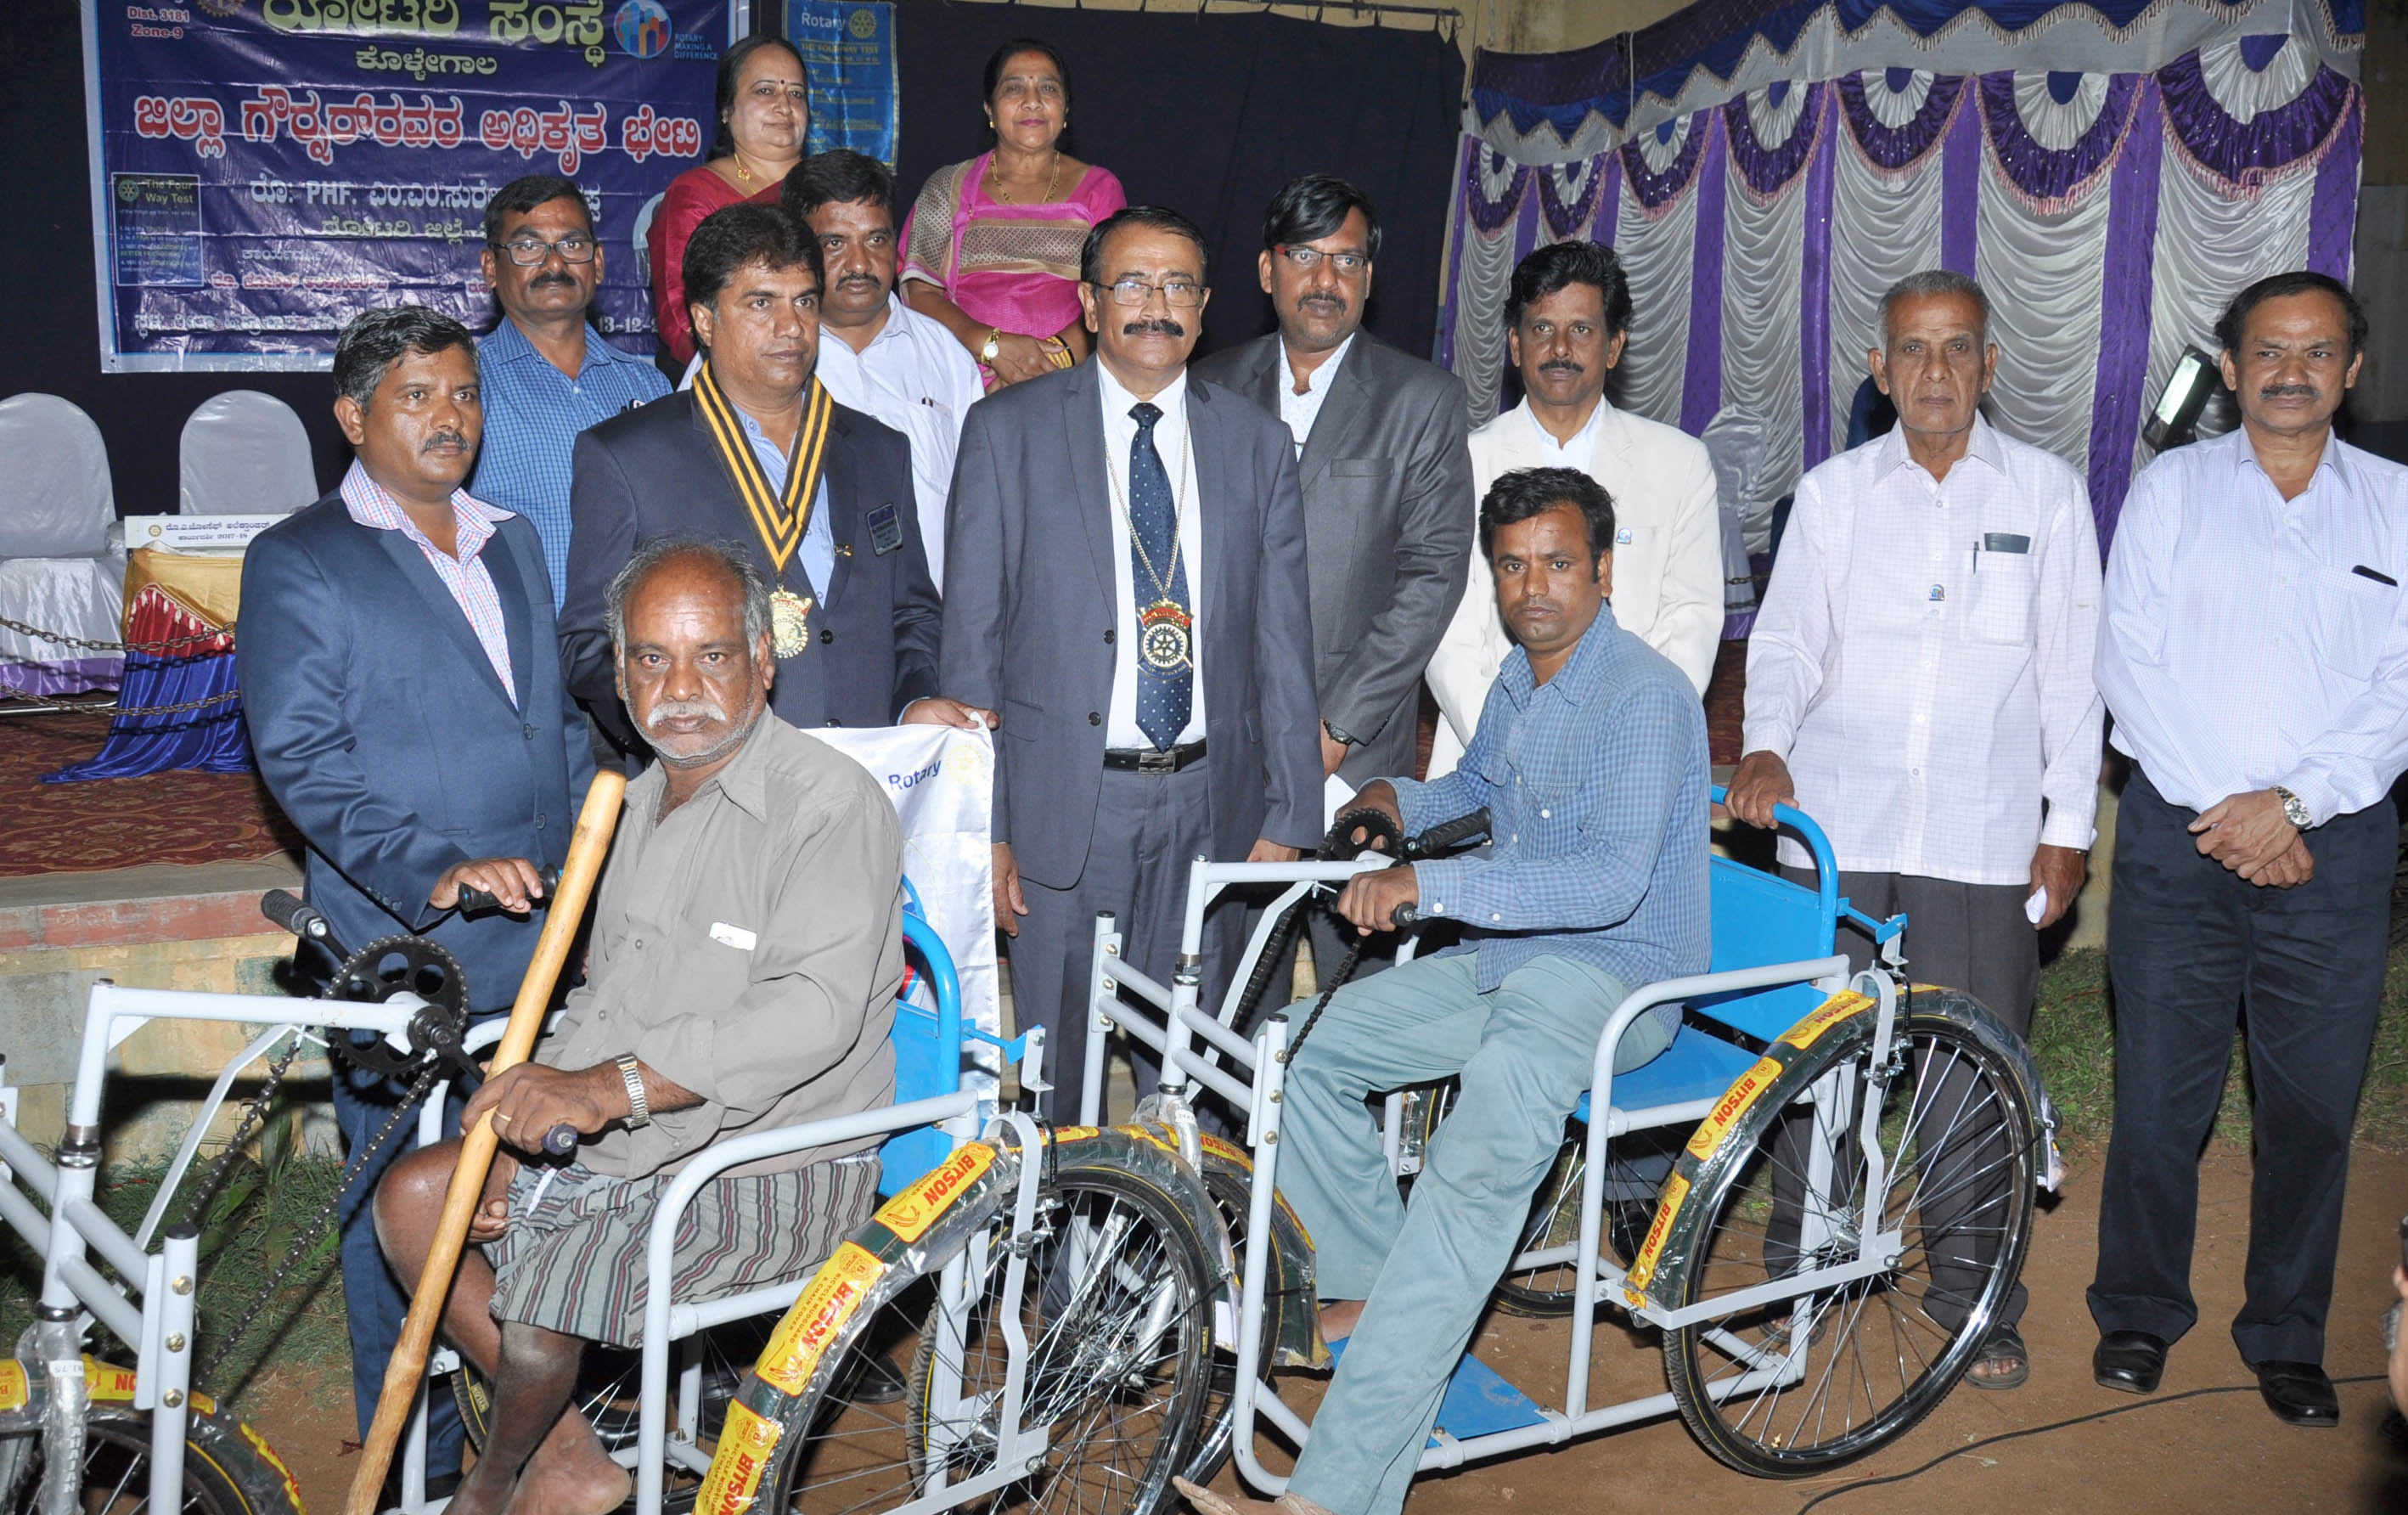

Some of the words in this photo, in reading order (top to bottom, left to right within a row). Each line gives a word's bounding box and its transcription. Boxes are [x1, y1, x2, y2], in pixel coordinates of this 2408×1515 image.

[127, 6, 158, 20] Dist.
[159, 8, 189, 23] 3181
[801, 12, 846, 30] Rotary
[132, 24, 183, 39] Zone-9
[145, 193, 168, 204] Way
[171, 194, 194, 204] Test
[307, 181, 357, 206] PHF.
[888, 761, 942, 791] Rotary
[1713, 1078, 1756, 1127] BITSON
[924, 1155, 976, 1207] BITSON
[1644, 1202, 1671, 1258] BITSON
[806, 1283, 823, 1306] CHAIN
[818, 1272, 841, 1303] BICYCLE
[788, 1306, 807, 1331] COVER
[790, 1304, 818, 1343] MUDGUARD
[802, 1281, 853, 1349] BITSON
[723, 1443, 740, 1474] BICYCLE
